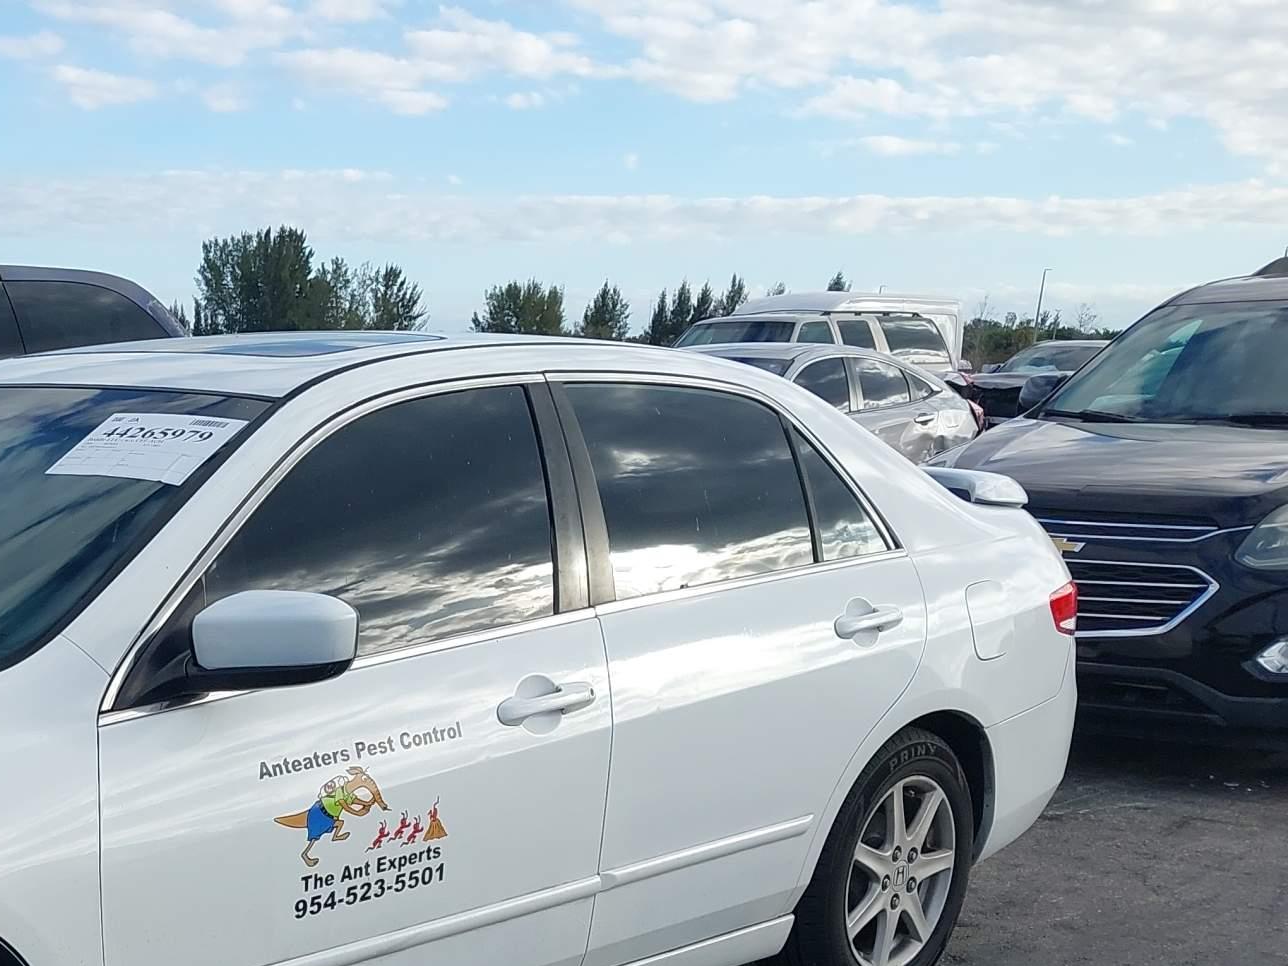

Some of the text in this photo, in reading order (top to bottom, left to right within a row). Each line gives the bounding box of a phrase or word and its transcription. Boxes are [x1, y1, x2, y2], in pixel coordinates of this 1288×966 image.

[102, 426, 214, 443] 44265979
[259, 721, 463, 780] Anteaters Pest Control
[294, 863, 445, 920] 954-523-5501
[301, 845, 442, 893] The Ant Experts
